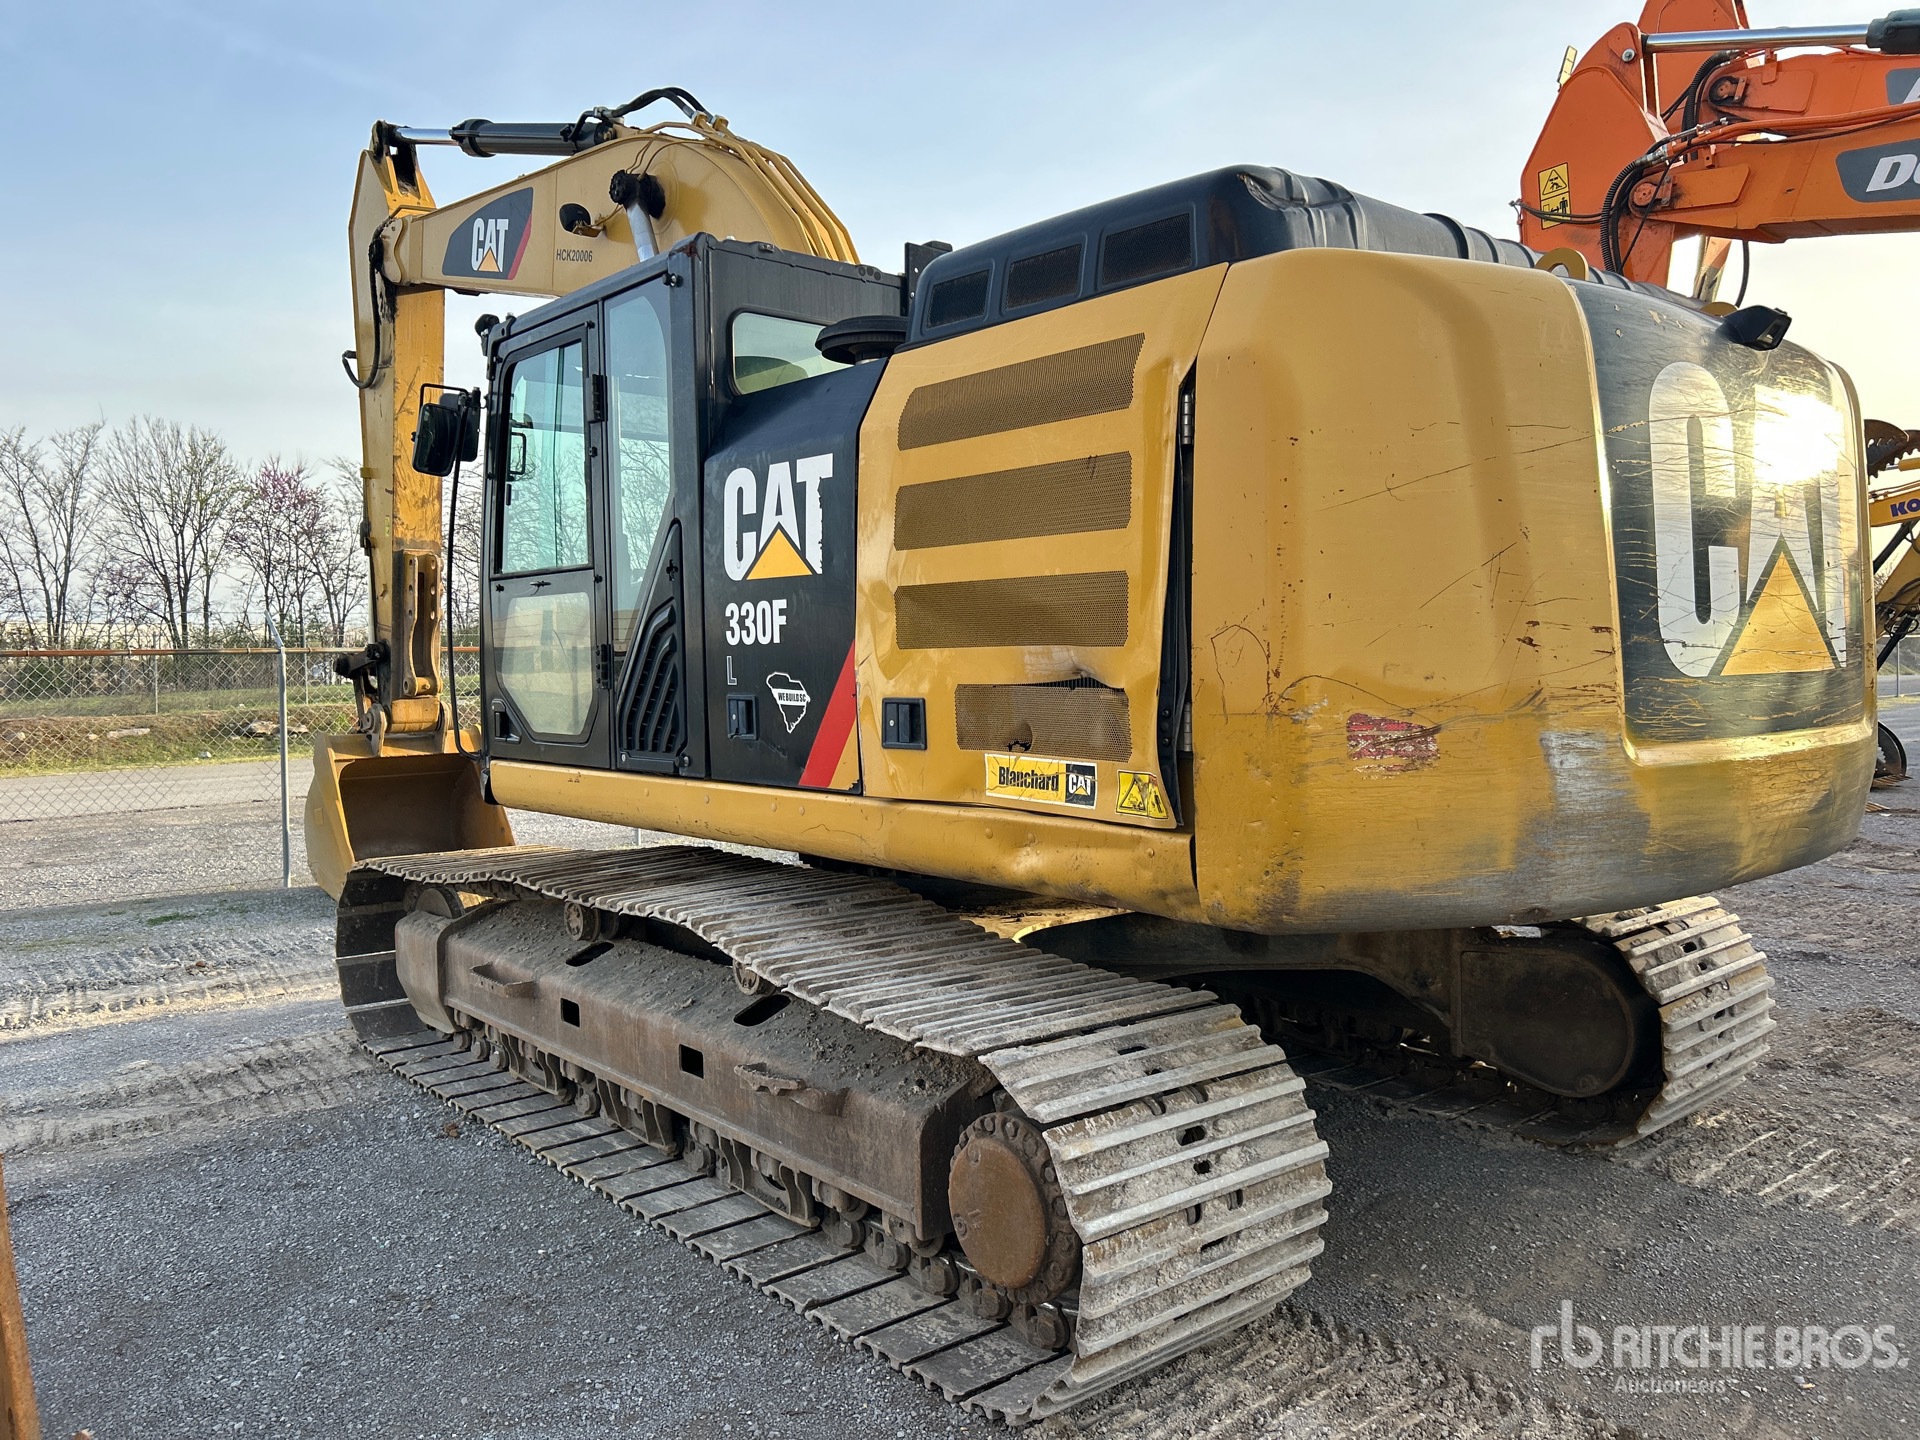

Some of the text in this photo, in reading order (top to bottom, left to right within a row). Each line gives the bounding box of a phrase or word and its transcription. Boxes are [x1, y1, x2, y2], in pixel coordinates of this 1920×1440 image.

[471, 217, 509, 272] CAT
[556, 249, 593, 263] HCK20006
[723, 453, 834, 581] CAT
[1649, 361, 1849, 677] CAT
[725, 599, 787, 646] 330F
[726, 655, 737, 685] L
[998, 766, 1059, 792] Blanchard
[1068, 773, 1091, 795] CAT
